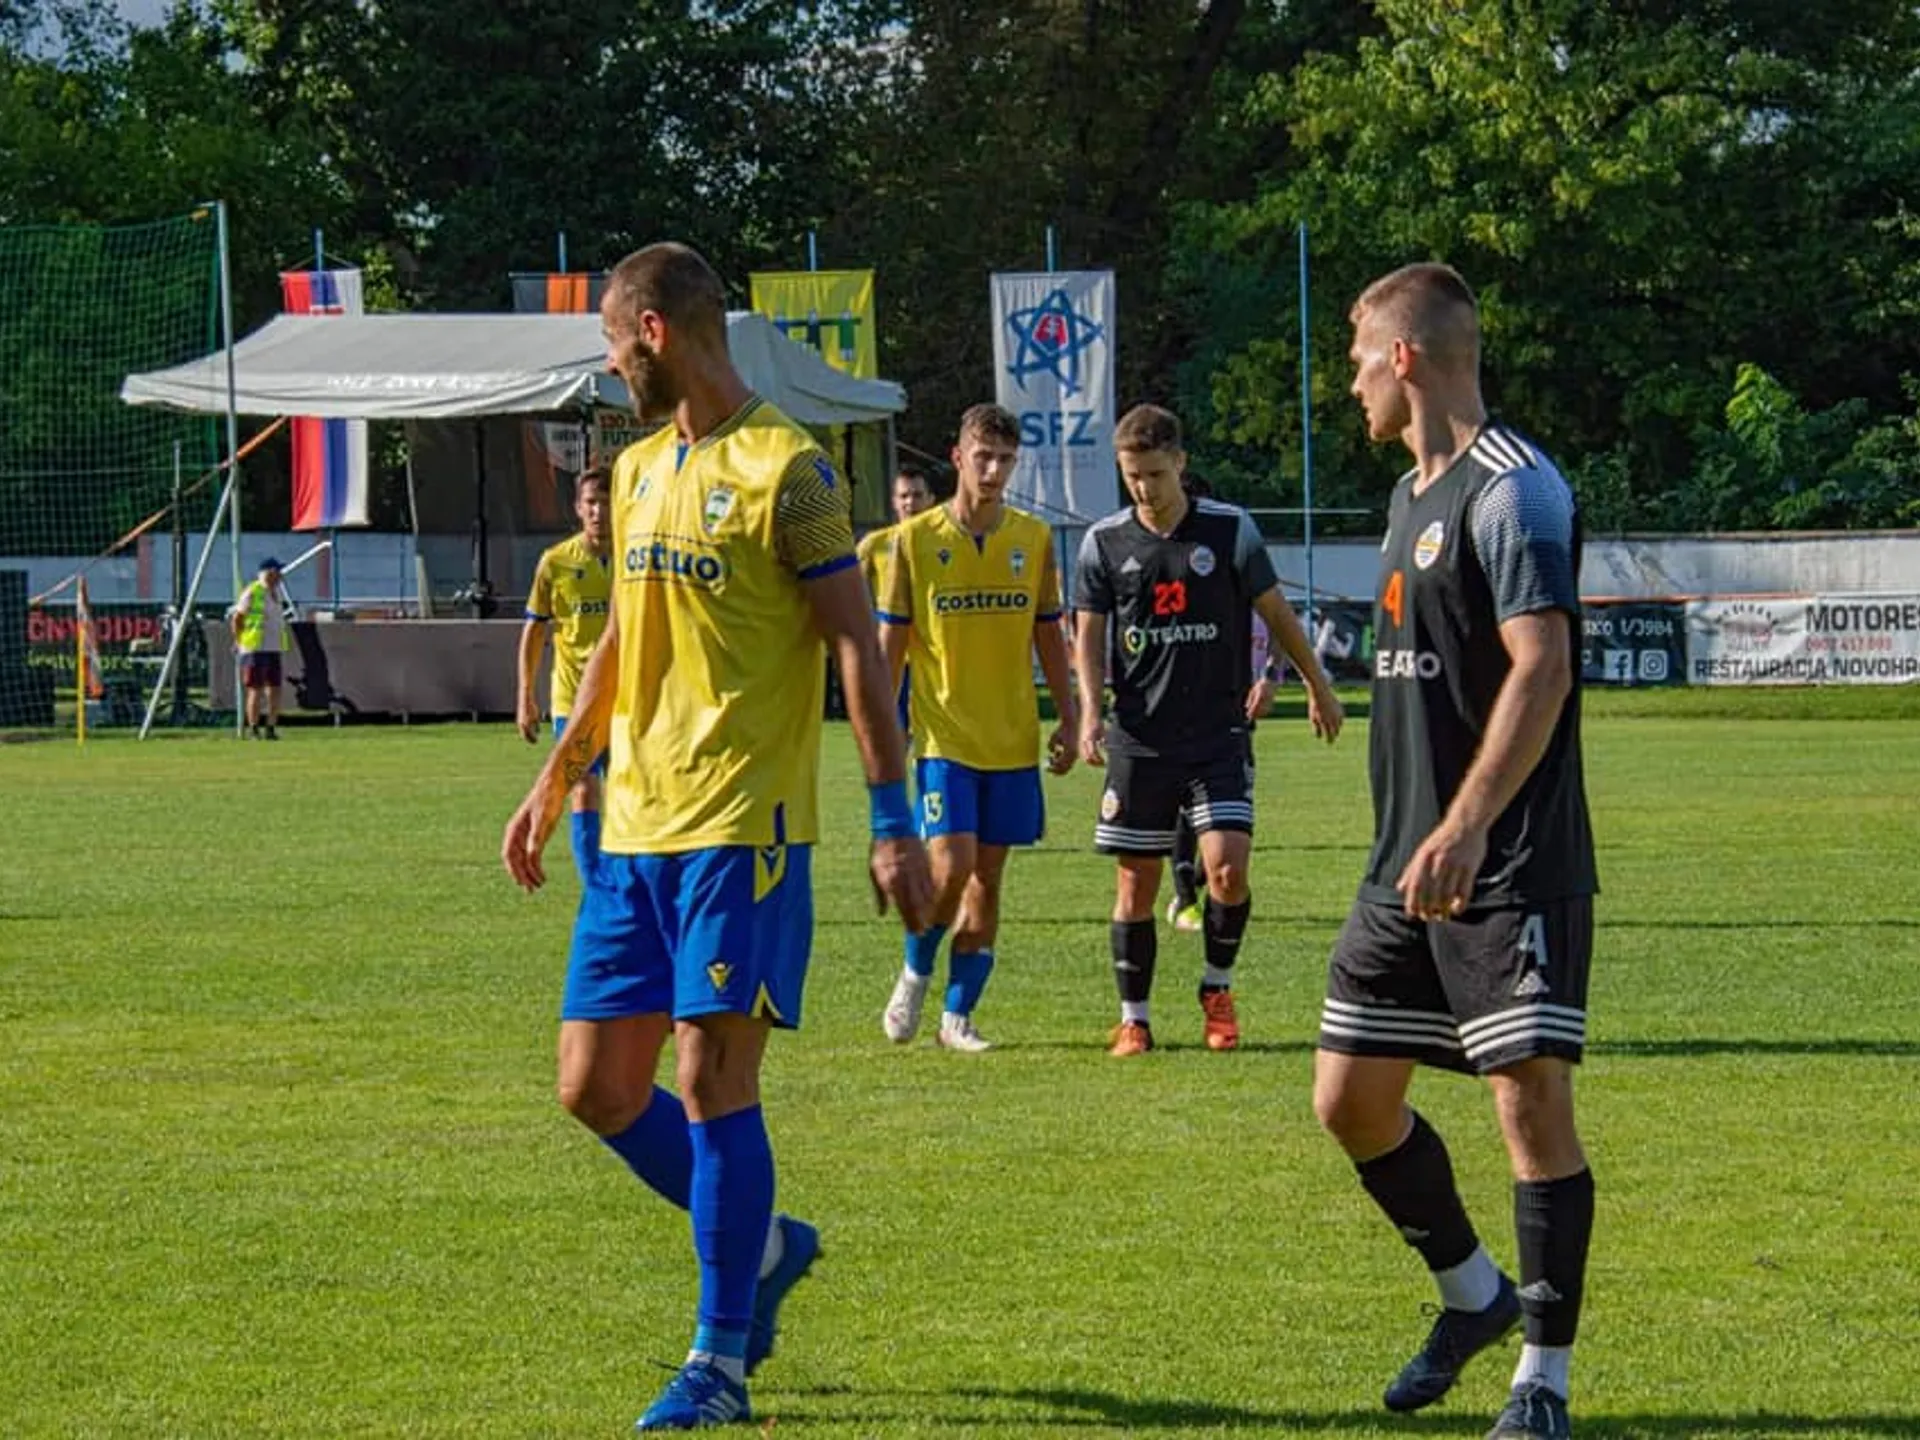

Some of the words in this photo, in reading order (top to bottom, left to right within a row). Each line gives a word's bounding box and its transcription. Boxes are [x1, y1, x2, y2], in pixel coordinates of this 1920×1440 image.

[1020, 410, 1097, 447] SFZ
[937, 592, 1028, 612] costruo
[1154, 579, 1186, 616] 23
[1383, 569, 1404, 629] 4
[1148, 623, 1219, 645] TEATRO
[1805, 604, 1920, 633] MOTORE
[1832, 656, 1920, 677] NOVOHR
[923, 791, 943, 825] 13
